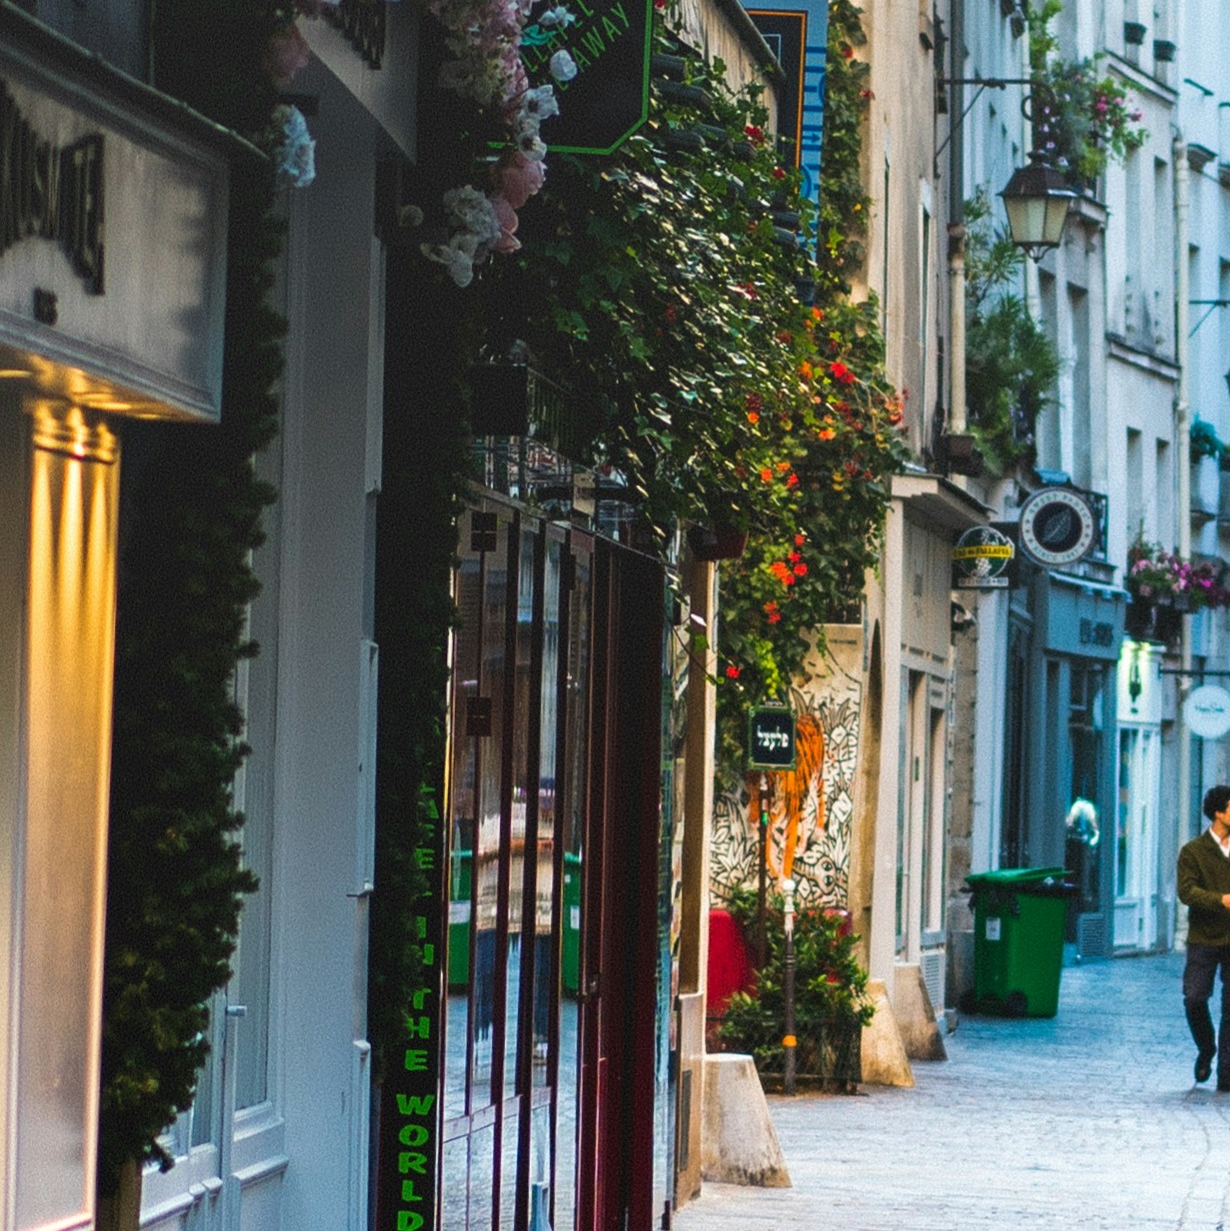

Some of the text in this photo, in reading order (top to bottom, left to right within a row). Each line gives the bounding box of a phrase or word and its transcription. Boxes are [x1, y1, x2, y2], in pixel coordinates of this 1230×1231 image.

[571, 1, 630, 74] AWAY
[404, 988, 432, 1071] THE
[396, 1093, 435, 1231] WORLD
